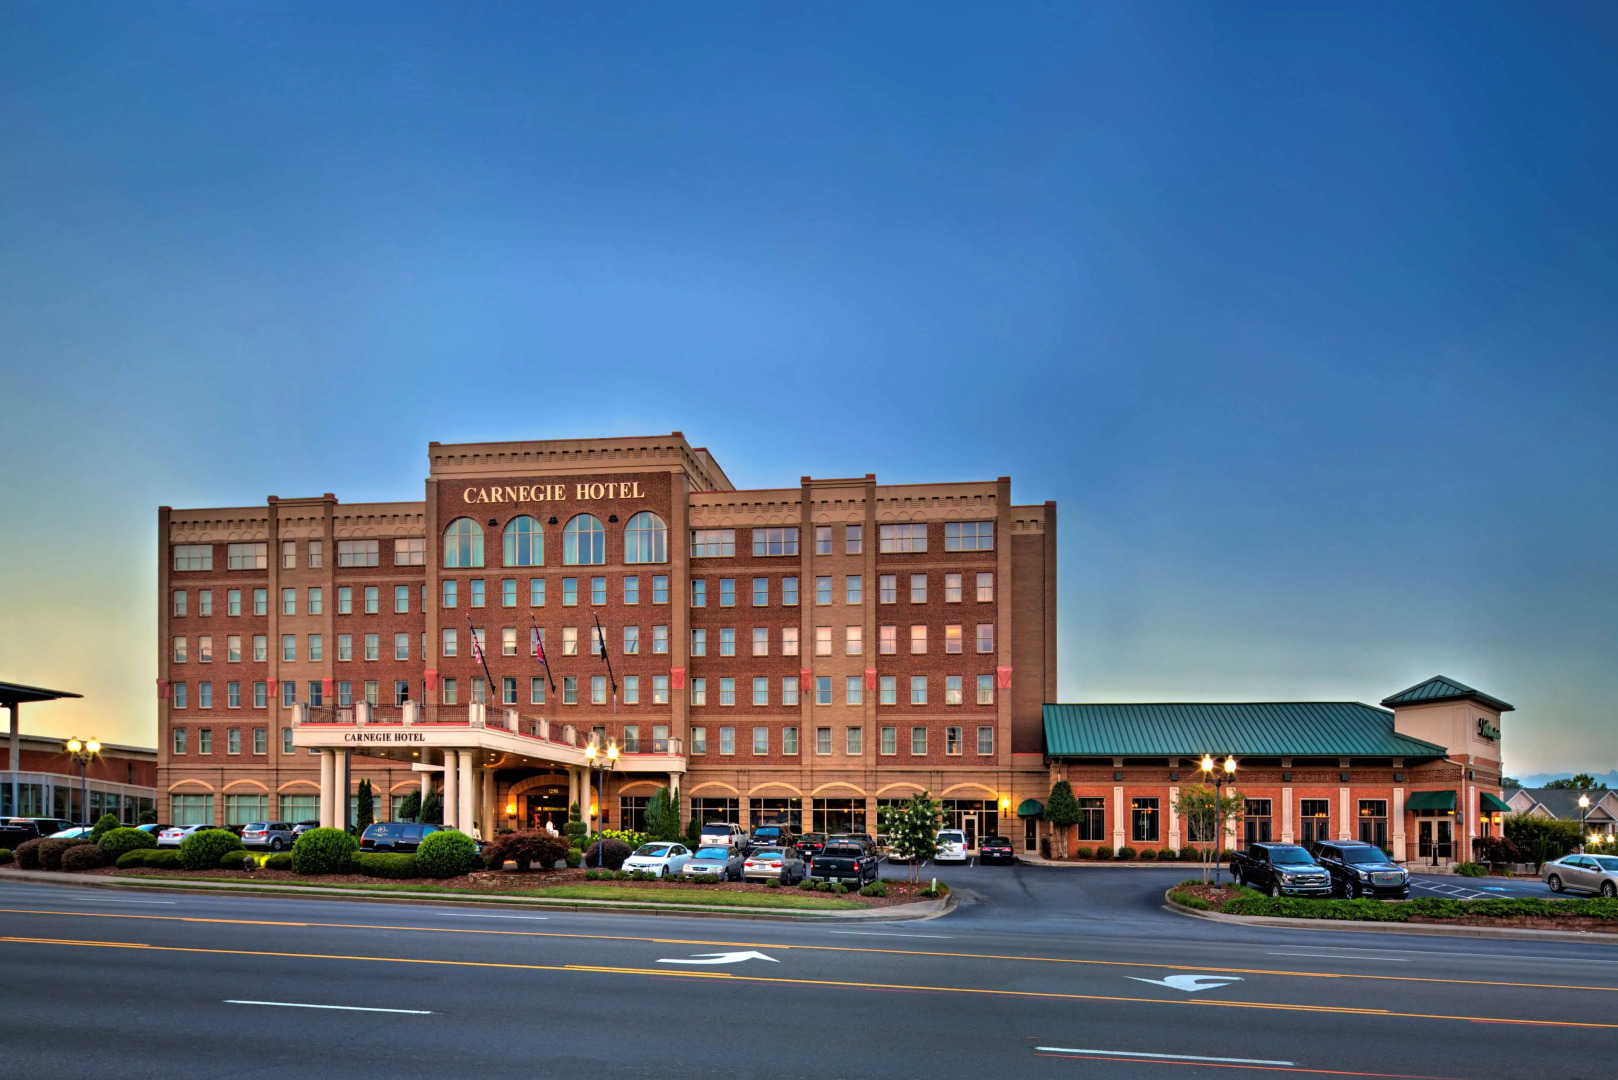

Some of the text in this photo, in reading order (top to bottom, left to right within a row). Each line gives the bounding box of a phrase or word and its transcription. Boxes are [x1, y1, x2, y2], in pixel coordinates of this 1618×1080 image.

[463, 482, 645, 504] CARNEGIE HOTEL
[344, 733, 425, 742] CARNEGIE HOTEL
